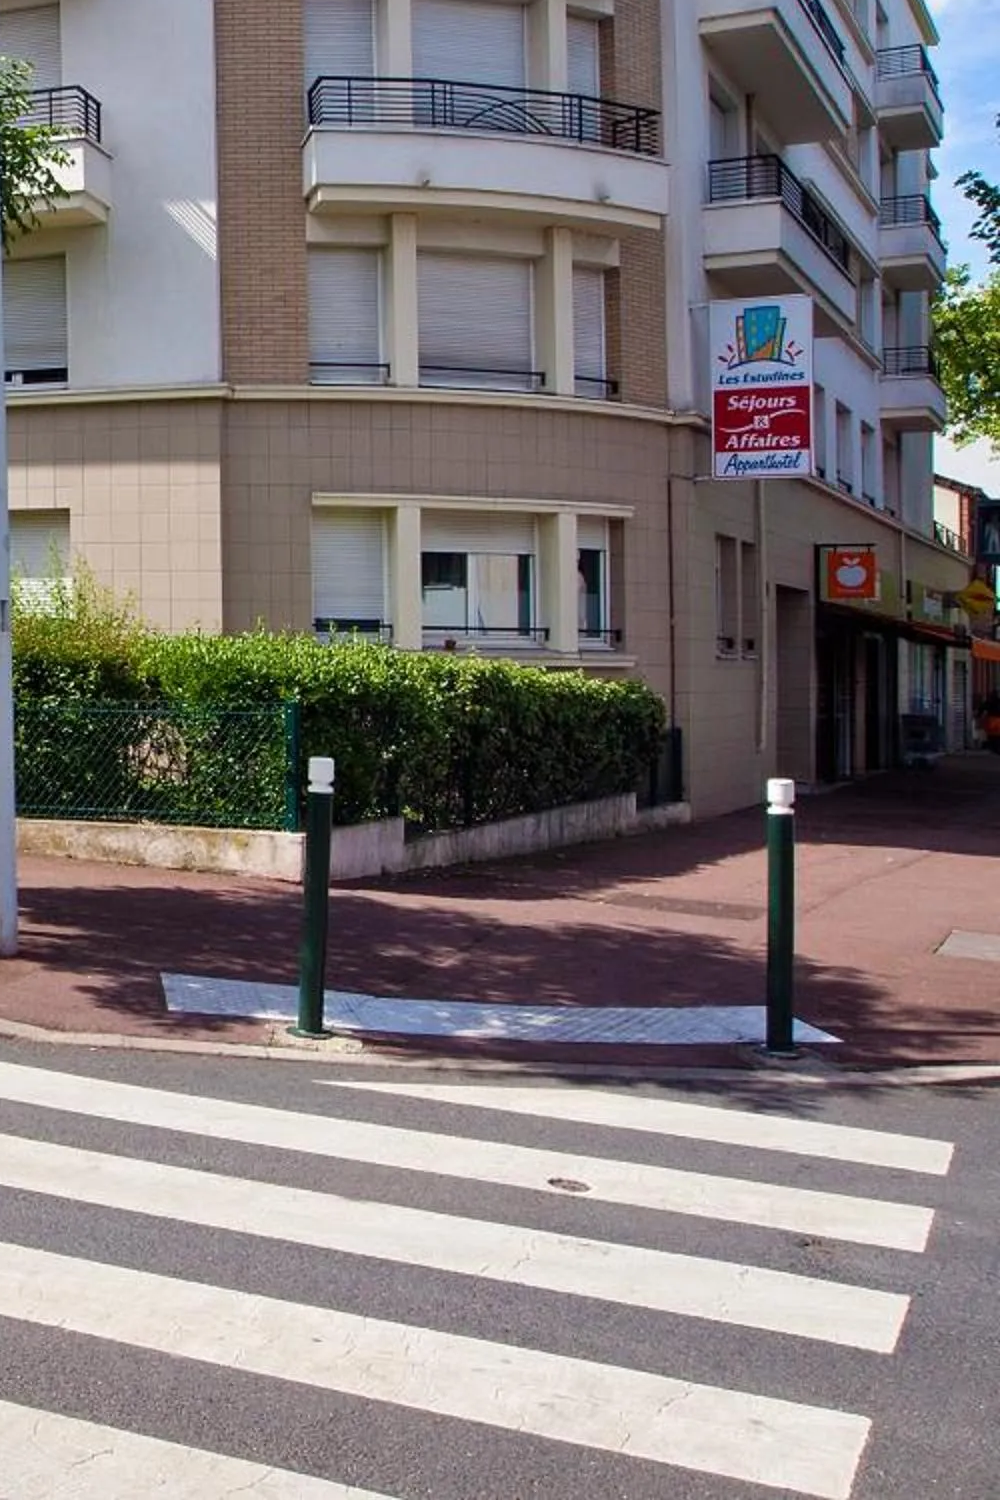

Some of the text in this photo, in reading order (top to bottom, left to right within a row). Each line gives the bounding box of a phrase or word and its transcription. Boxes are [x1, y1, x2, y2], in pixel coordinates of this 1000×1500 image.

[718, 374, 740, 385] Les
[727, 395, 797, 412] Séjours
[725, 433, 801, 449] Affaires
